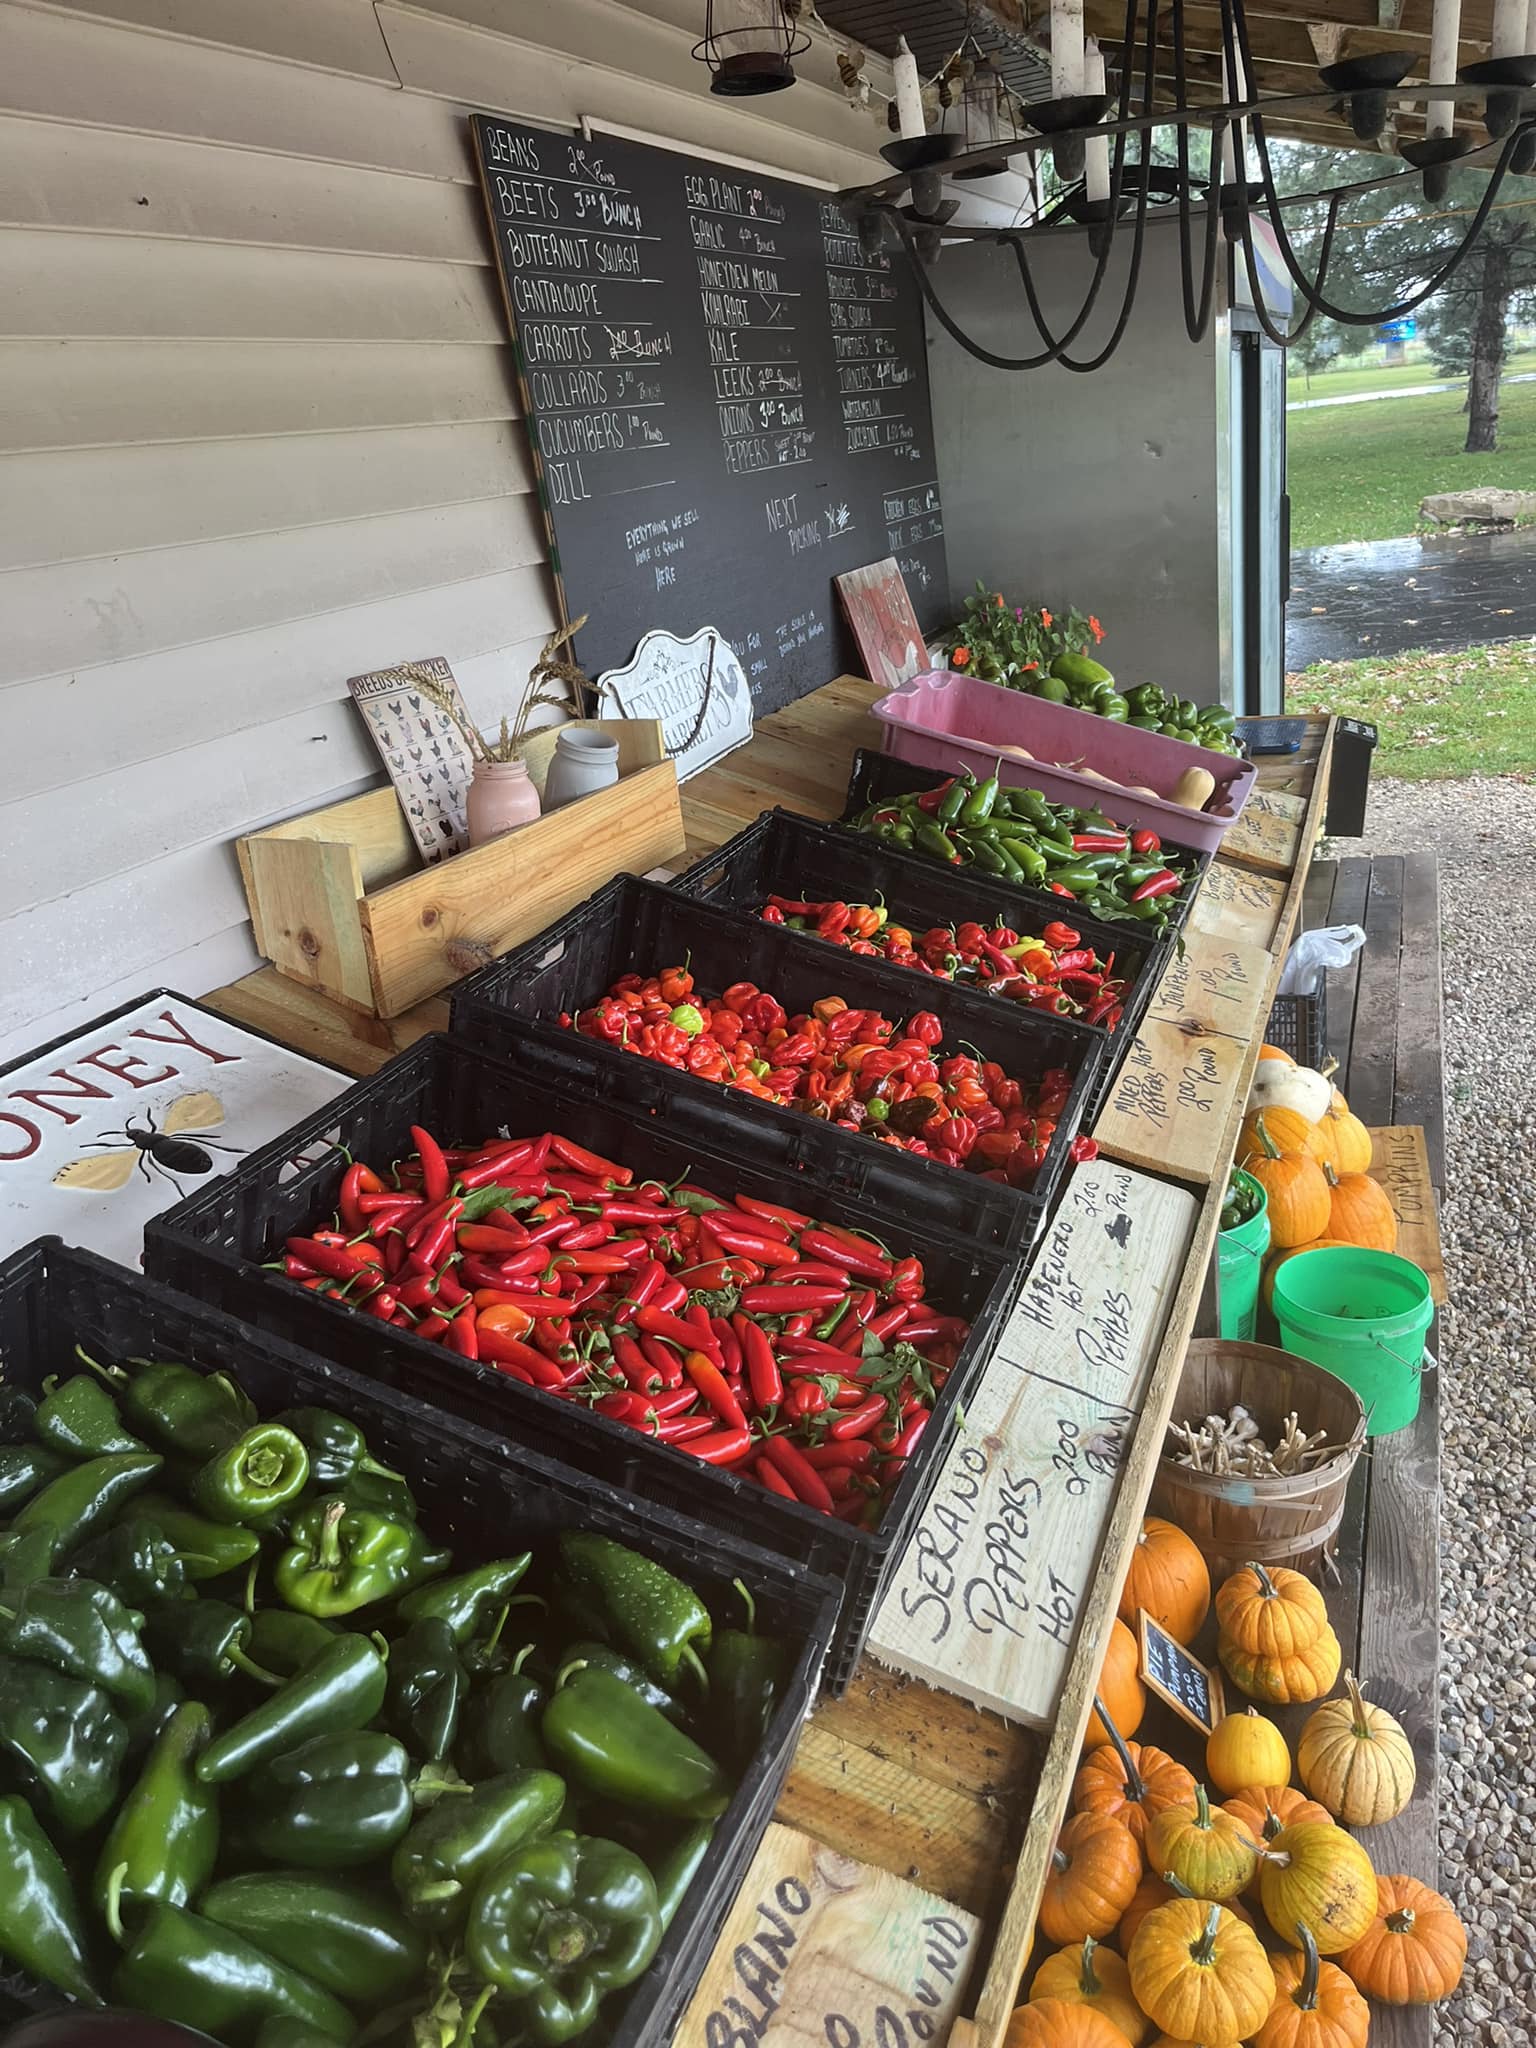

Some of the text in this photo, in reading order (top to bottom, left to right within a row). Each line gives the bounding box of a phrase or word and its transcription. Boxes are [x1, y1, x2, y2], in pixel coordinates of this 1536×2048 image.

[486, 126, 540, 172] BEANS
[495, 176, 560, 220] BEETS
[598, 191, 643, 231] BUNCH
[684, 175, 709, 208] EGG
[709, 177, 743, 214] PLANT
[506, 228, 641, 275] BUTTERNUT SQUASH
[690, 215, 726, 249] GARLIC
[823, 236, 865, 268] POTATOES
[696, 256, 779, 292] HONEYDEW MELON
[513, 275, 602, 317] CANTALOUPE
[701, 290, 751, 326] KOHLRABI
[523, 324, 593, 363] CARROTS
[708, 328, 741, 363] KALE
[532, 370, 608, 410] COLLARDS
[713, 365, 755, 399] LEEKS
[538, 411, 625, 459] CUCUMBERS
[719, 402, 755, 437] ONIONS
[723, 438, 770, 475] PEPPERS
[548, 459, 592, 505] DILL
[625, 519, 670, 550] EVERYTHING
[683, 508, 700, 527] SELL
[766, 492, 798, 533] NEXT
[787, 520, 823, 557] PICKING
[654, 565, 677, 592] HERE
[1212, 952, 1250, 984] POUND
[1113, 1041, 1153, 1118] MIXED HOT
[1192, 1047, 1222, 1085] POUND
[1138, 1071, 1171, 1129] PEPPERS
[1104, 1173, 1133, 1213] POUND
[1385, 1133, 1425, 1226] PUMPKINS
[1016, 1221, 1075, 1331] HABENERO
[1060, 1270, 1086, 1316] HOT
[1075, 1289, 1133, 1377] PEPPERS
[901, 1446, 989, 1645] SERANO
[962, 1468, 1042, 1639] PEPPERS
[1036, 1563, 1077, 1648] HOT
[1146, 1636, 1168, 1687] PIE
